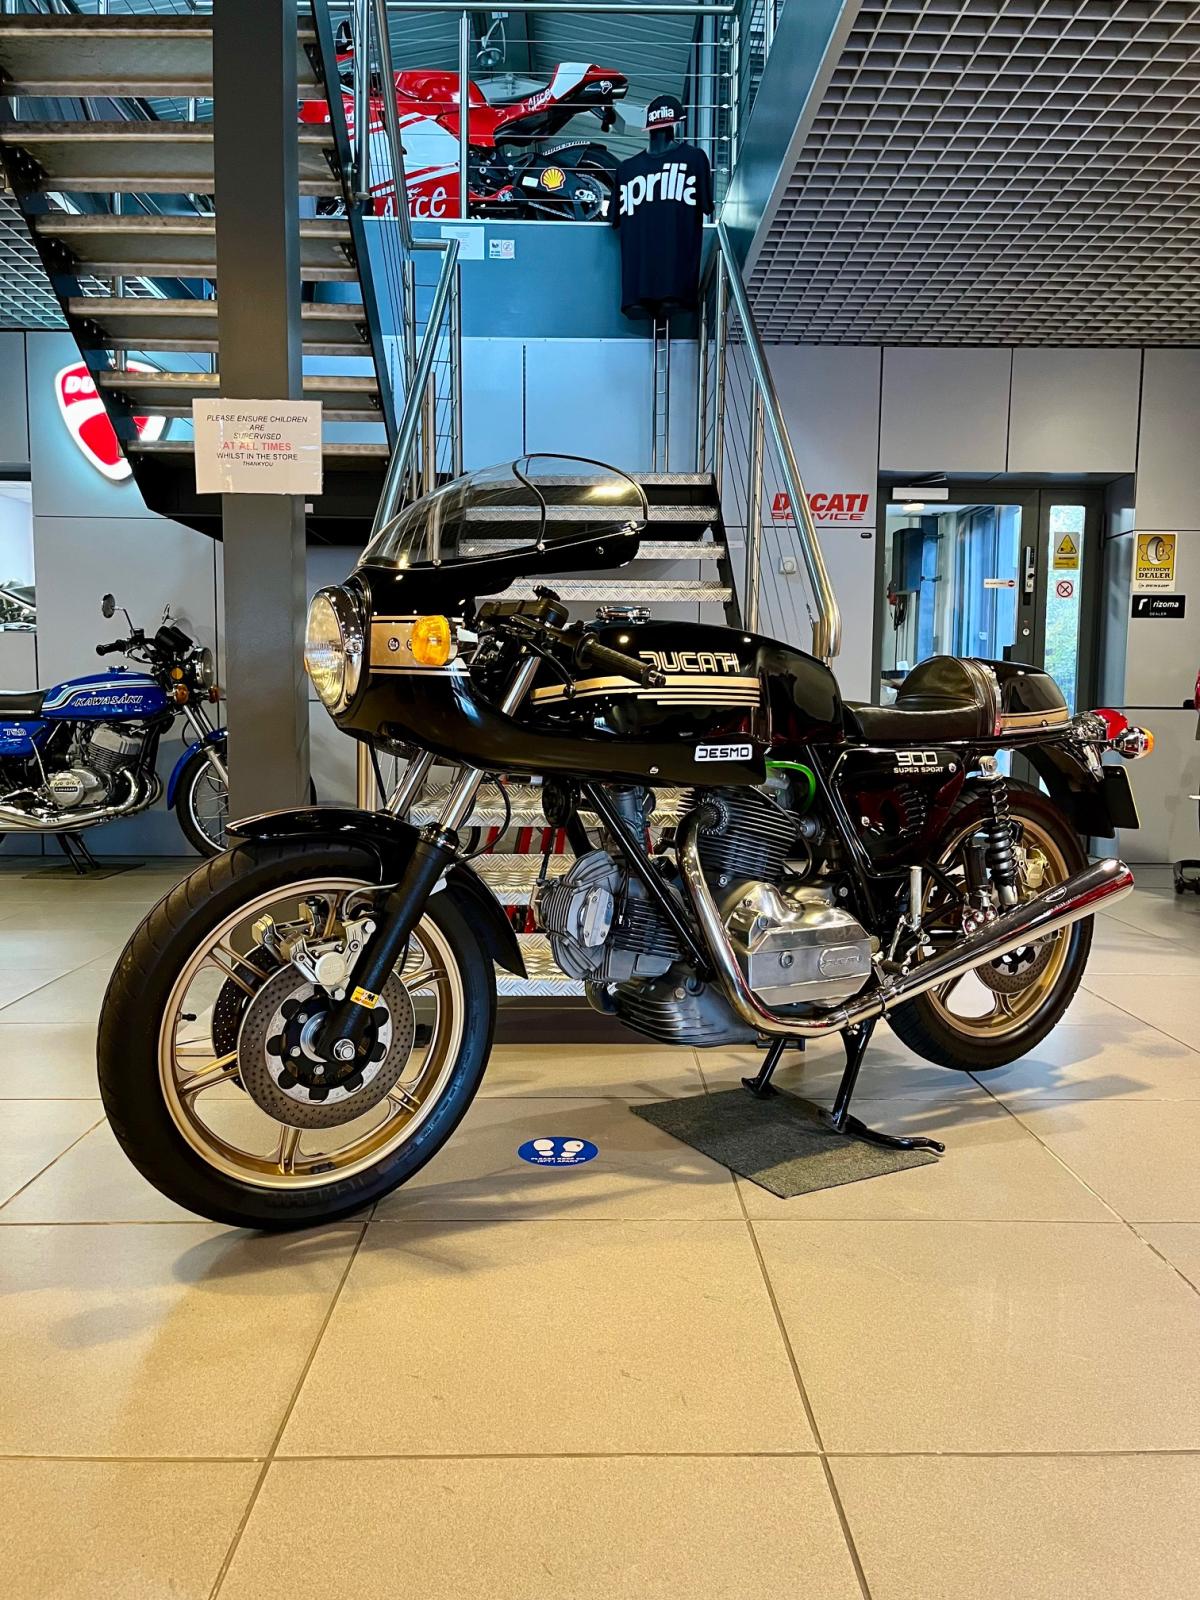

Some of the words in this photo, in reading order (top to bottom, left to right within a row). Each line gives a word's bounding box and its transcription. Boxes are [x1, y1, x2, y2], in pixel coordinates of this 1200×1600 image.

[648, 106, 675, 122] aprilia
[237, 415, 267, 423] ENSURE
[233, 432, 282, 440] SUPERVISED
[223, 441, 235, 450] AT
[239, 442, 258, 450] ALL
[262, 442, 292, 451] TIMES
[772, 493, 870, 512] DCATI
[771, 512, 865, 521] SEVICE
[1152, 600, 1180, 608] rizoma
[639, 650, 741, 673] DUCATI
[71, 694, 144, 707] KAWASAKI
[697, 746, 750, 759] DESMO
[895, 751, 938, 766] 900
[893, 766, 920, 774] SUPER
